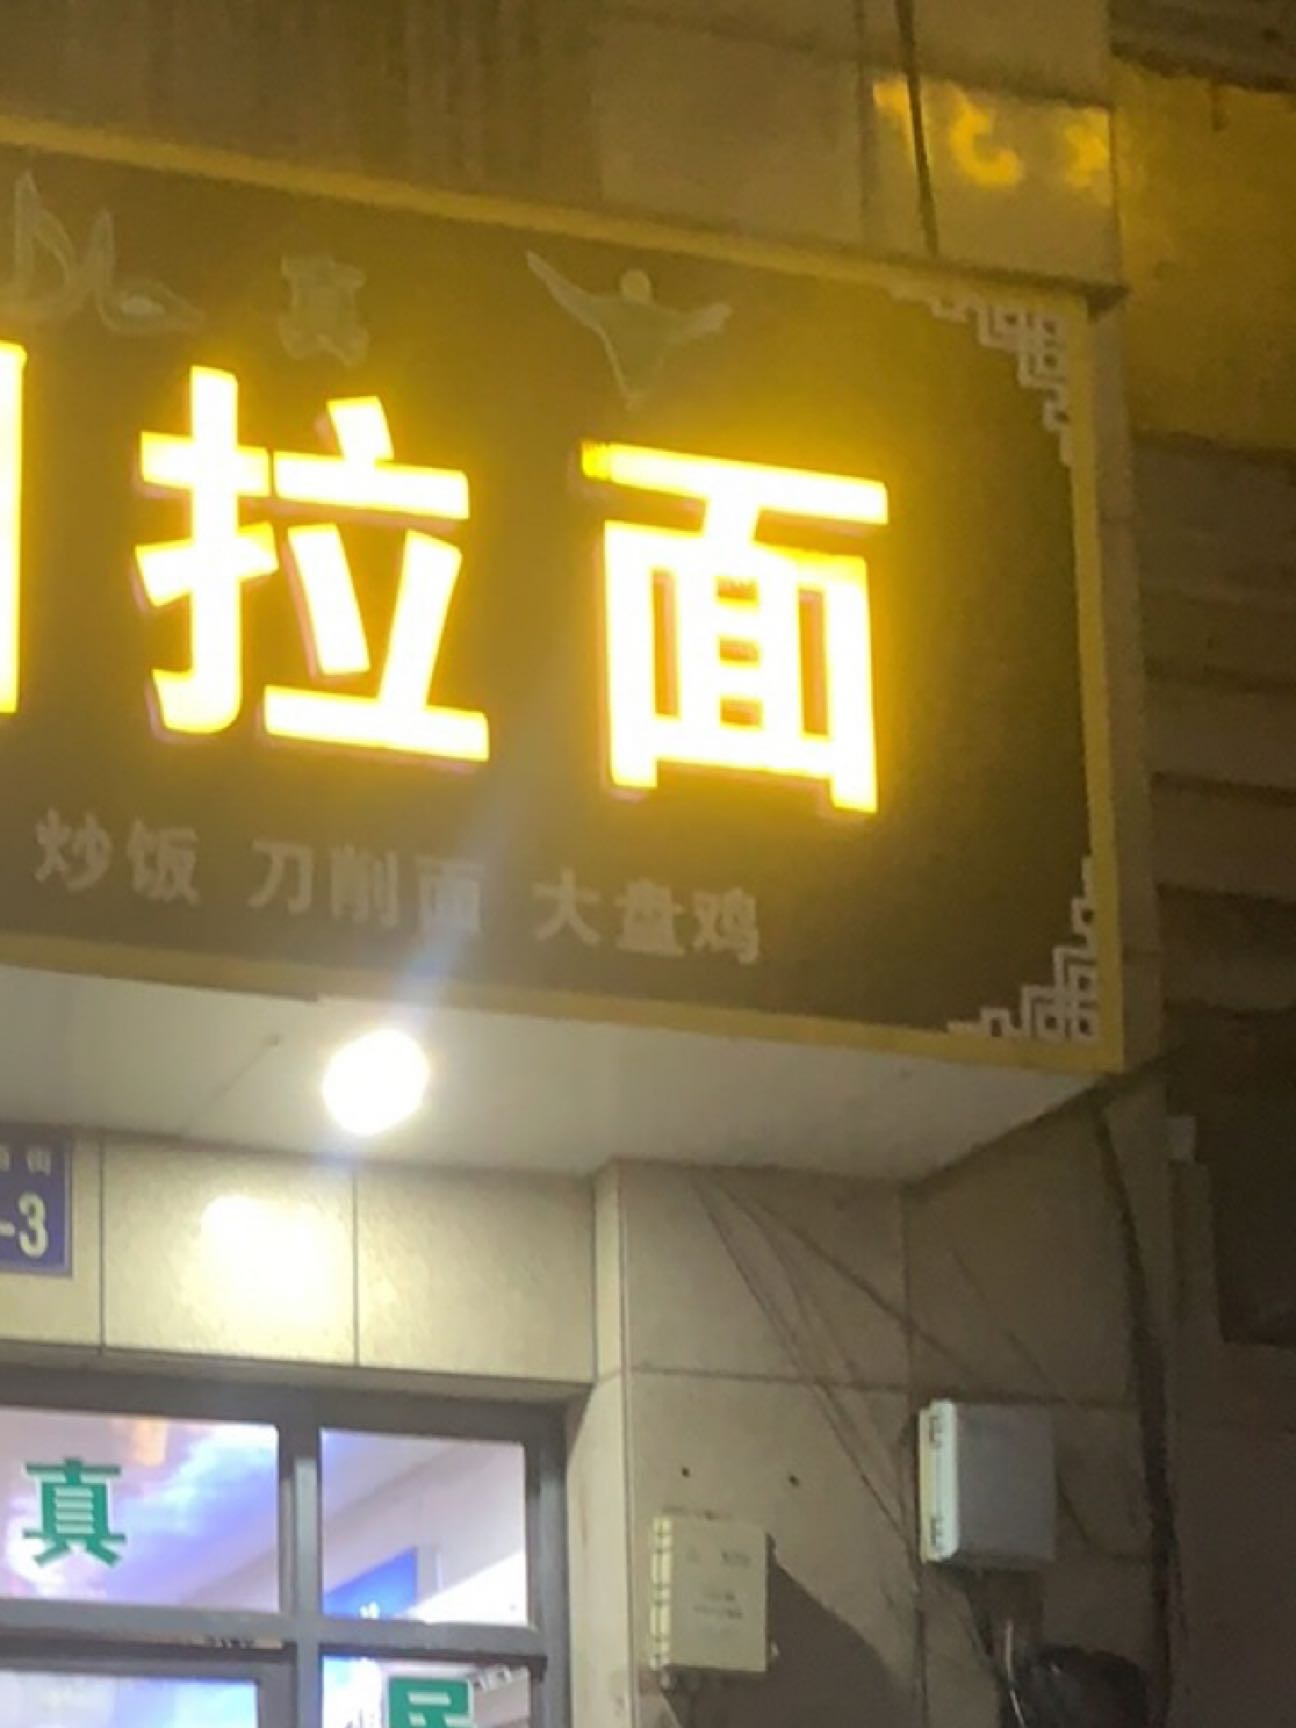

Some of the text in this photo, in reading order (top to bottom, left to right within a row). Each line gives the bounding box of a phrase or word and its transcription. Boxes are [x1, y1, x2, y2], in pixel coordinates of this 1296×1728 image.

[34, 807, 201, 906] 炒饭
[248, 838, 486, 934] 刀削面
[532, 866, 762, 966] 大盘鸡
